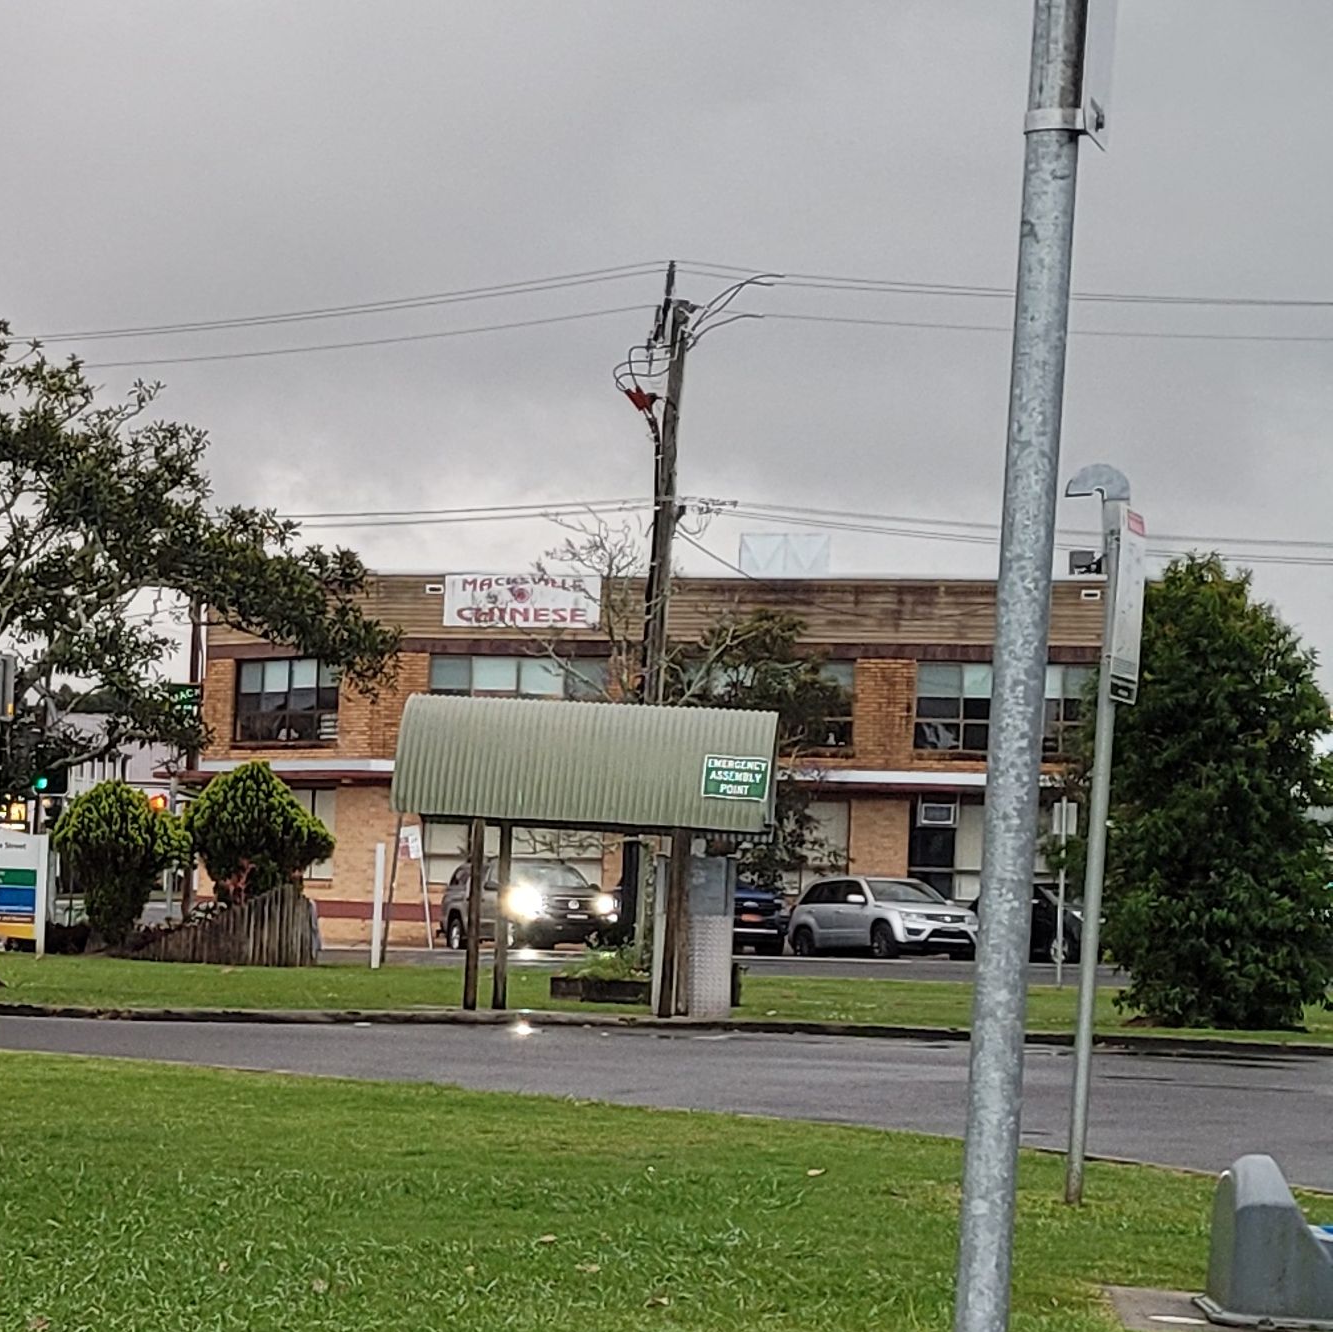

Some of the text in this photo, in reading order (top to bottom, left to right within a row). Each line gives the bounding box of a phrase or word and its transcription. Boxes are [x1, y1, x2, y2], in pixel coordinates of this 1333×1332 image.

[457, 607, 586, 622] CHINESE
[708, 759, 767, 771] EMERGENCY
[710, 771, 761, 783] ASSEMBLY
[719, 784, 749, 795] POINT
